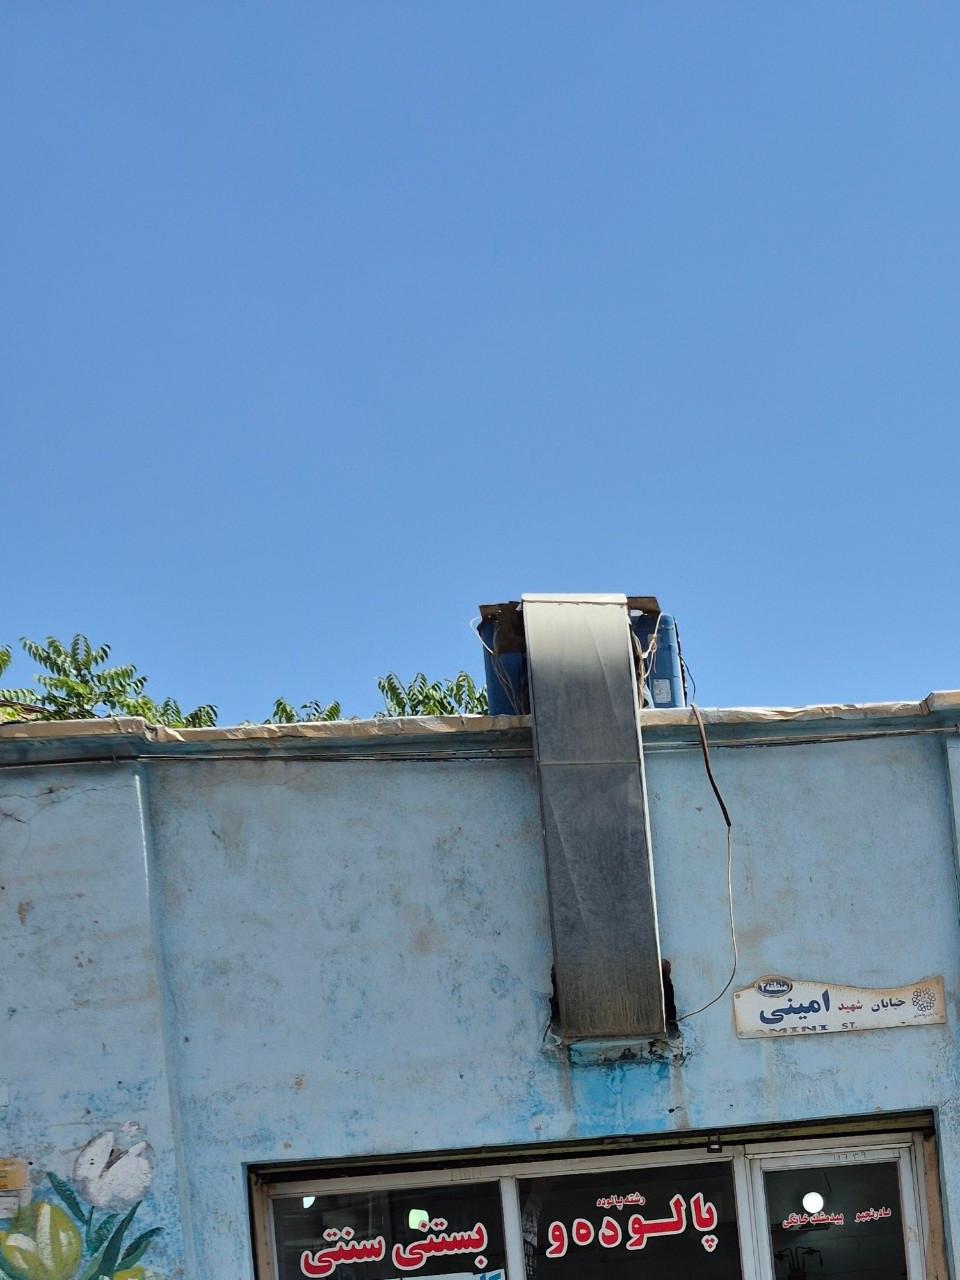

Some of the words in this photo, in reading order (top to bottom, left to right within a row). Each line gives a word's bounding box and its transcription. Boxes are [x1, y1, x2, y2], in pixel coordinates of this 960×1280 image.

[759, 988, 830, 1025] امینی
[837, 999, 863, 1014] شهید
[871, 997, 906, 1013] خیابان
[300, 1226, 386, 1279] سنتی
[392, 1217, 489, 1270] بستنی
[545, 1220, 568, 1258] و
